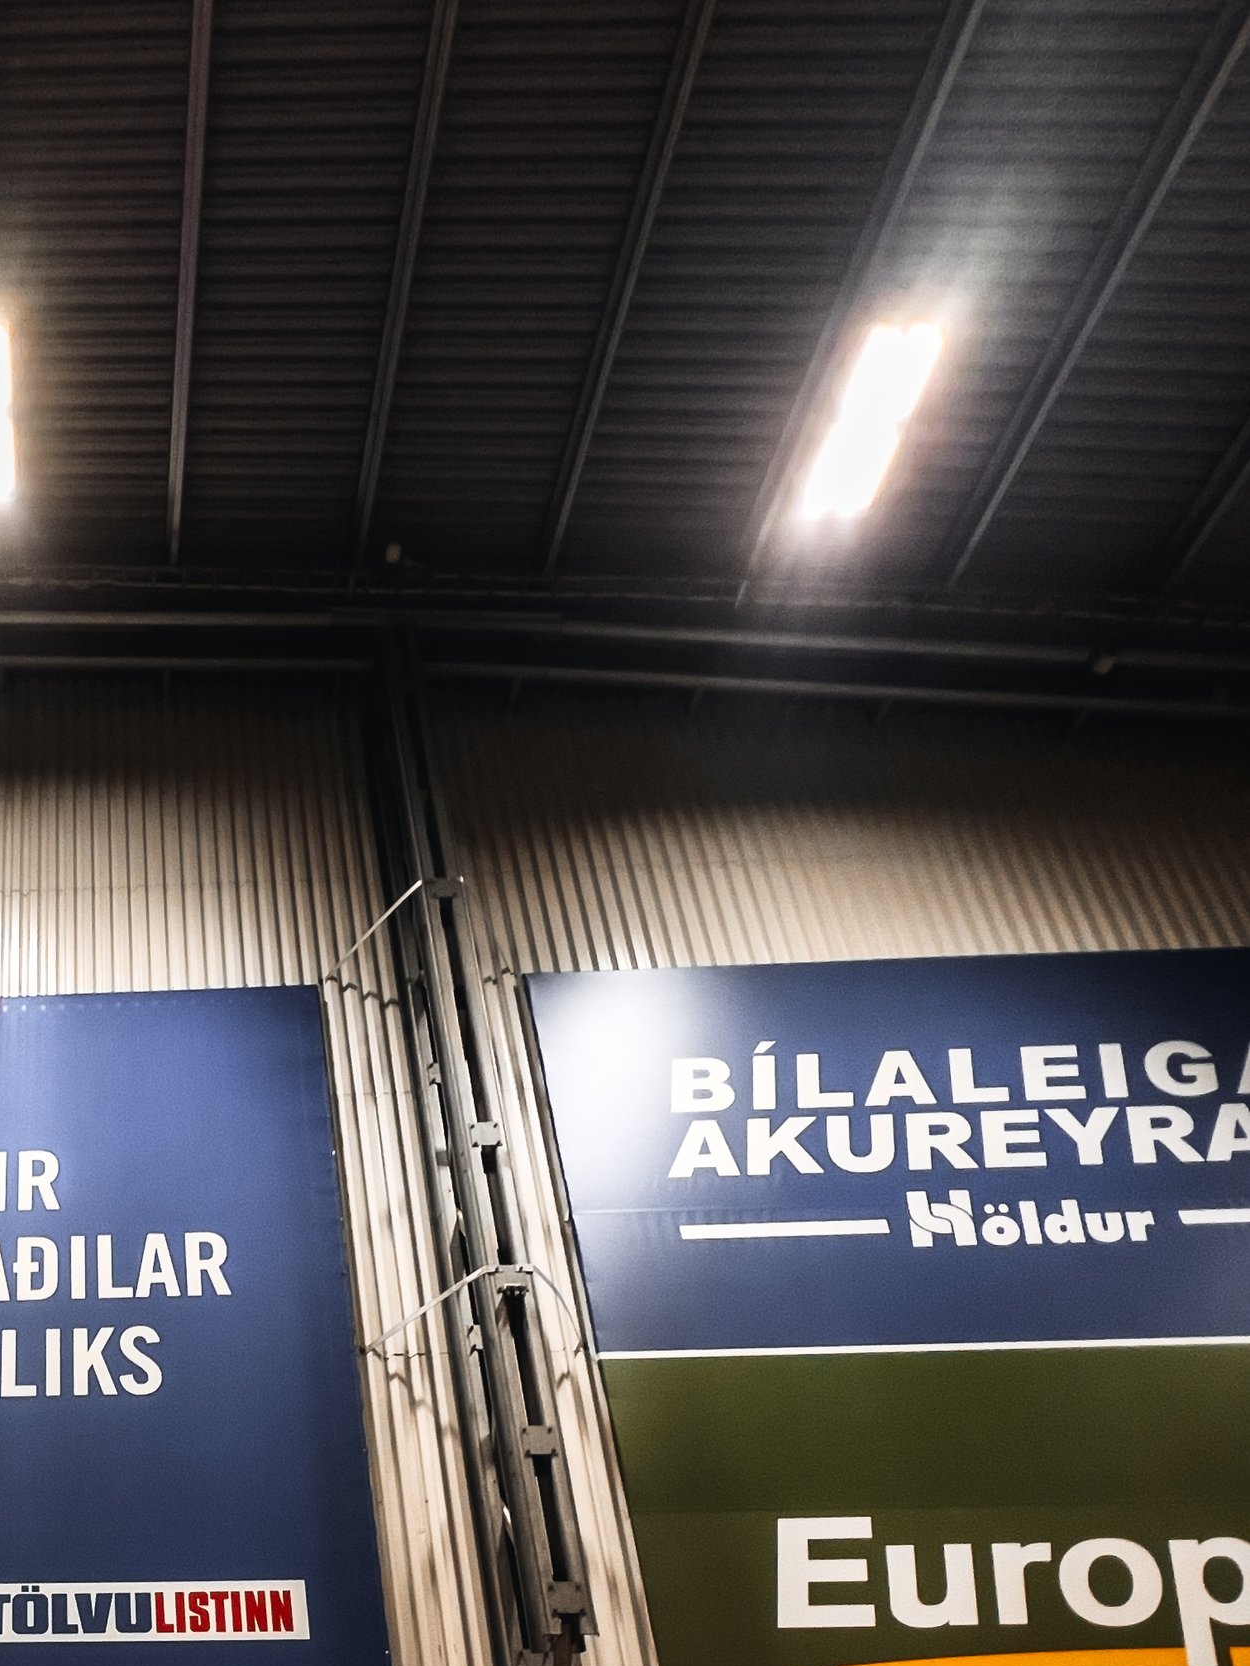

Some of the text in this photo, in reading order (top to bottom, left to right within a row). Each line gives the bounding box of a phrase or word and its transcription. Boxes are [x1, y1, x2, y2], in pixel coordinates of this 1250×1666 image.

[670, 1040, 1250, 1113] BÍLALEIG
[668, 1103, 1250, 1178] AKUREYRA
[906, 1190, 1156, 1248] Höldur
